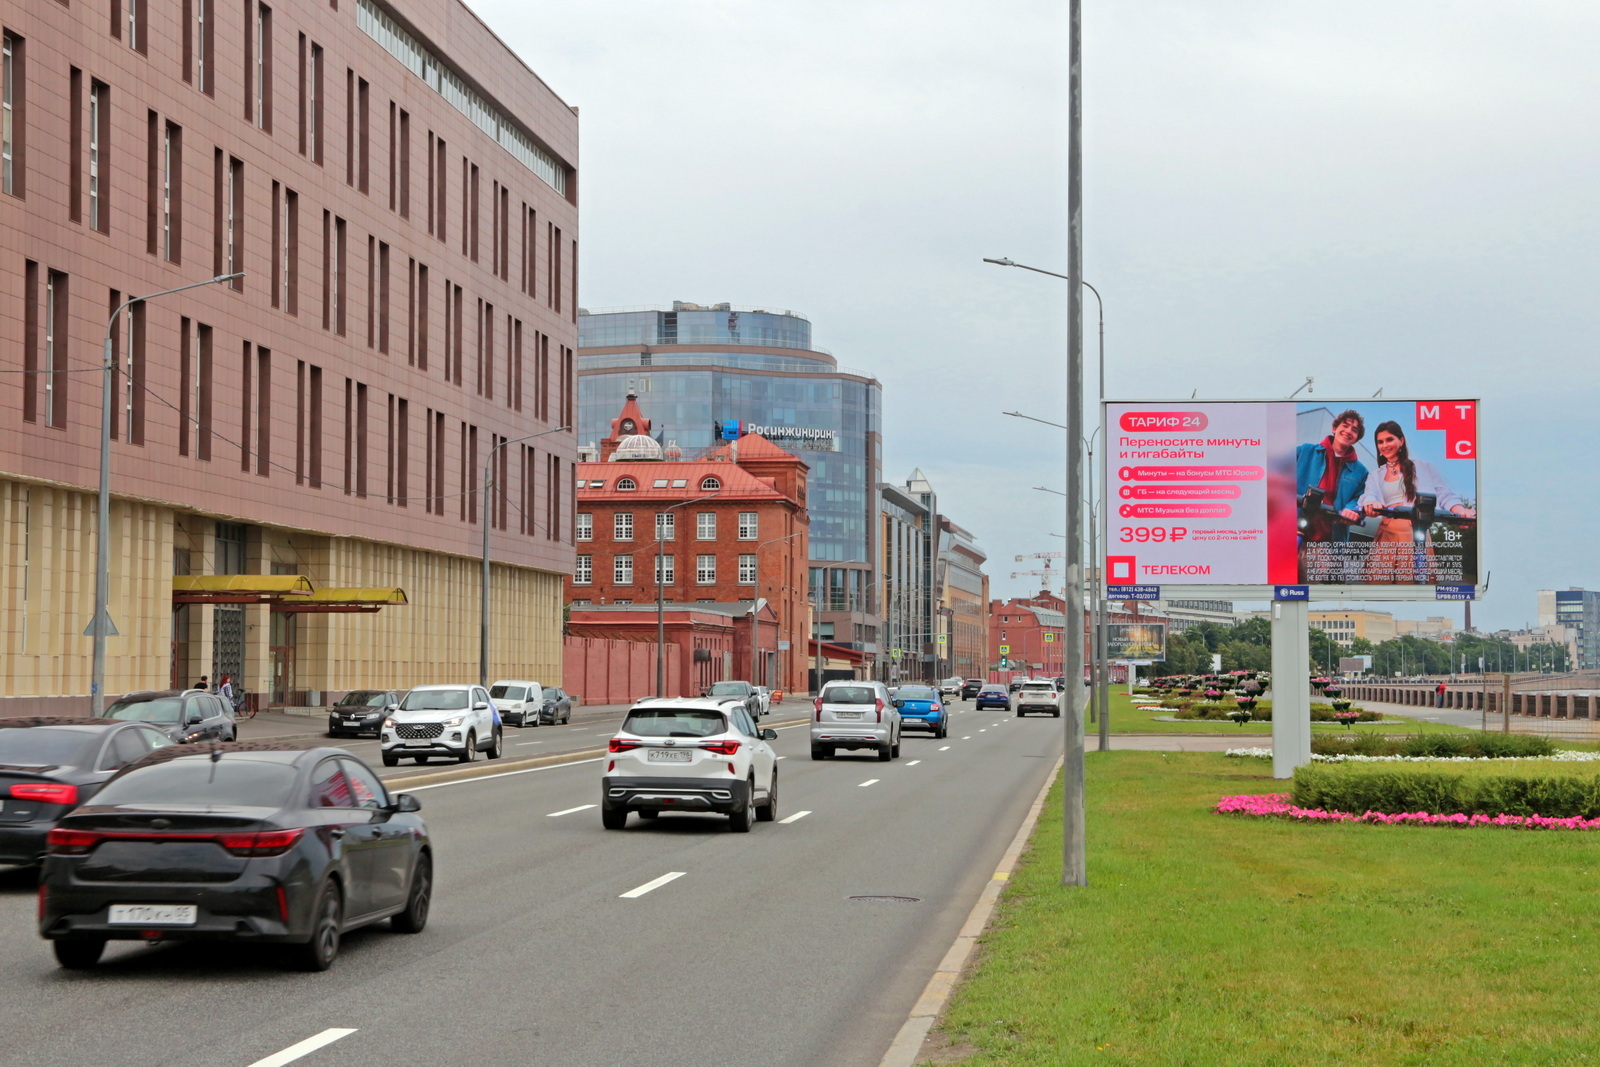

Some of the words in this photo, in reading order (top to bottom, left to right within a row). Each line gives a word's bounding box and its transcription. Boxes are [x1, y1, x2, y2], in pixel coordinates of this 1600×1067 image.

[1128, 416, 1180, 427] ТАРИФ
[1182, 416, 1200, 427] 24
[748, 424, 836, 440] Росинжиниринг
[1120, 437, 1204, 448] Переносите
[1207, 438, 1260, 448] минуты
[1131, 449, 1204, 458] гигабайты
[1120, 526, 1166, 542] 399
[1444, 530, 1462, 541] 18+
[1142, 565, 1210, 575] ТЕЛЕКОМ
